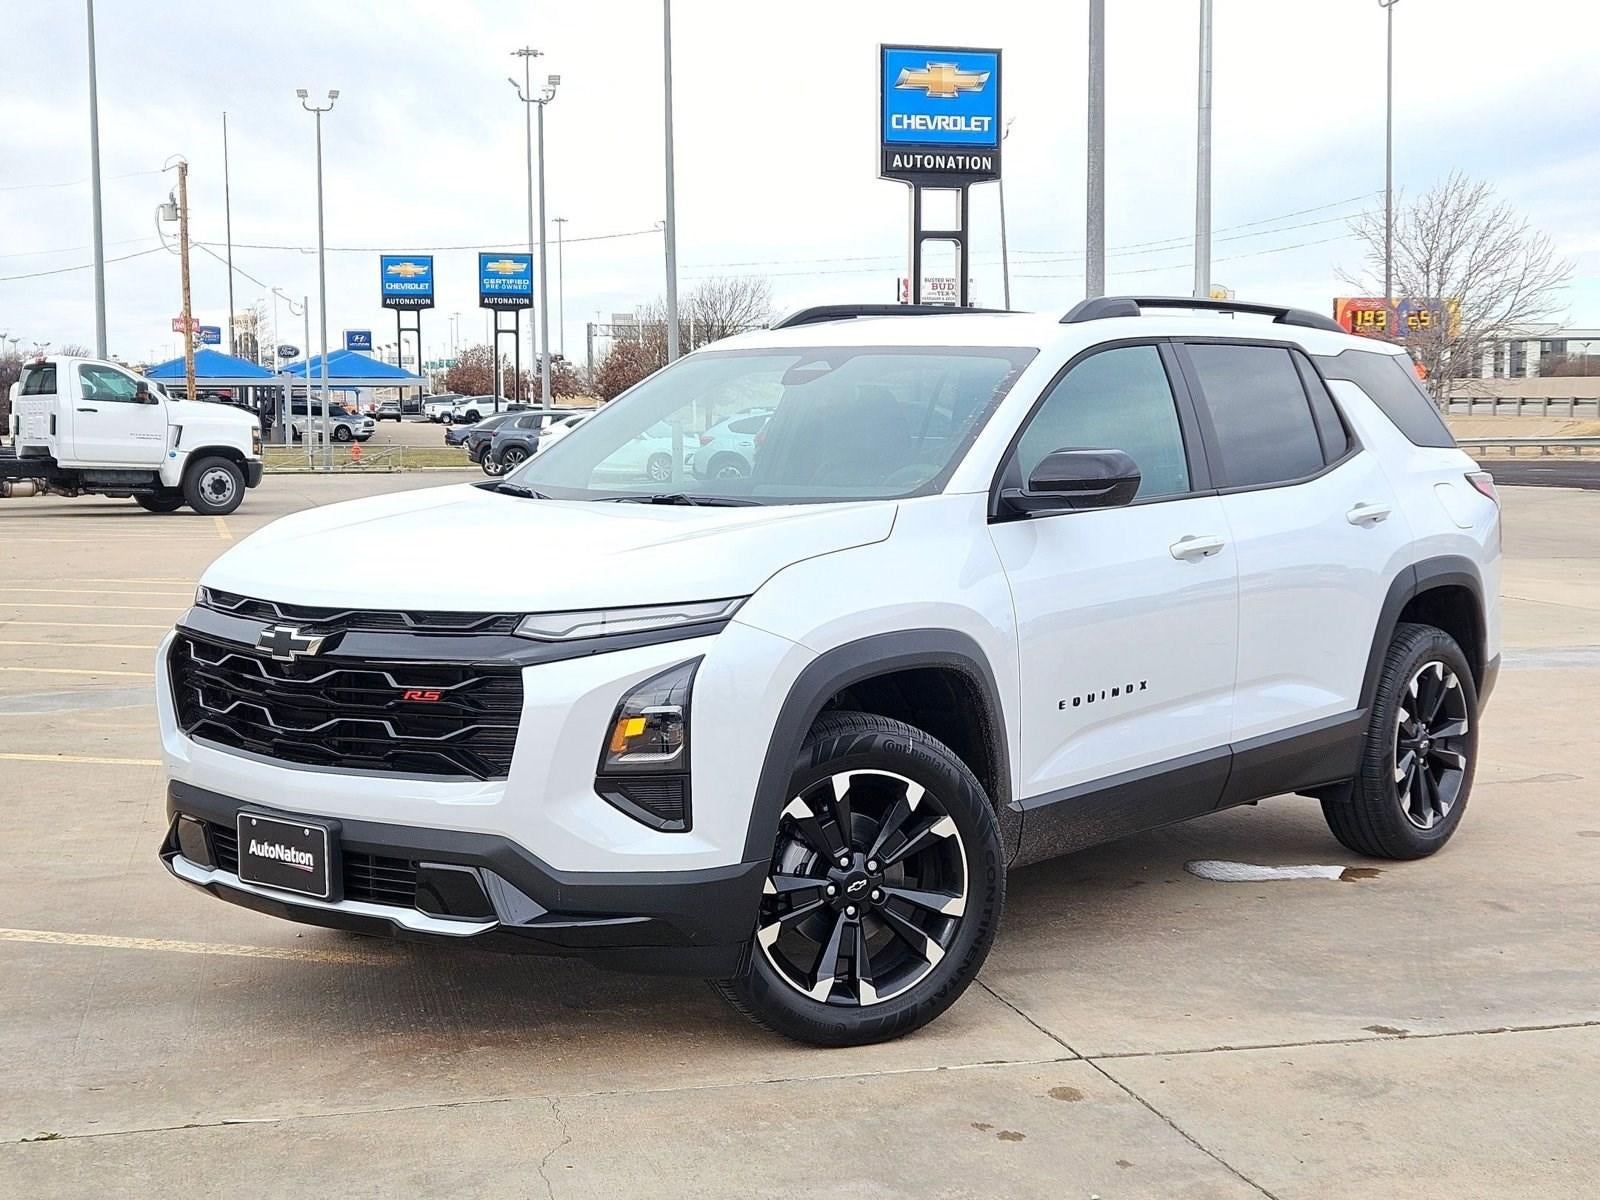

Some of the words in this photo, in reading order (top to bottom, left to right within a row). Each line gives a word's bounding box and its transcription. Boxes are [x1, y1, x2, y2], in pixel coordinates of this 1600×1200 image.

[891, 113, 992, 132] CHEVROLET
[892, 153, 992, 170] AUTONATION
[385, 282, 429, 290] CHEVROLET
[280, 346, 296, 356] Ford
[403, 690, 442, 701] RS
[1058, 680, 1148, 710] EQUINOX
[248, 839, 314, 866] AutoNation
